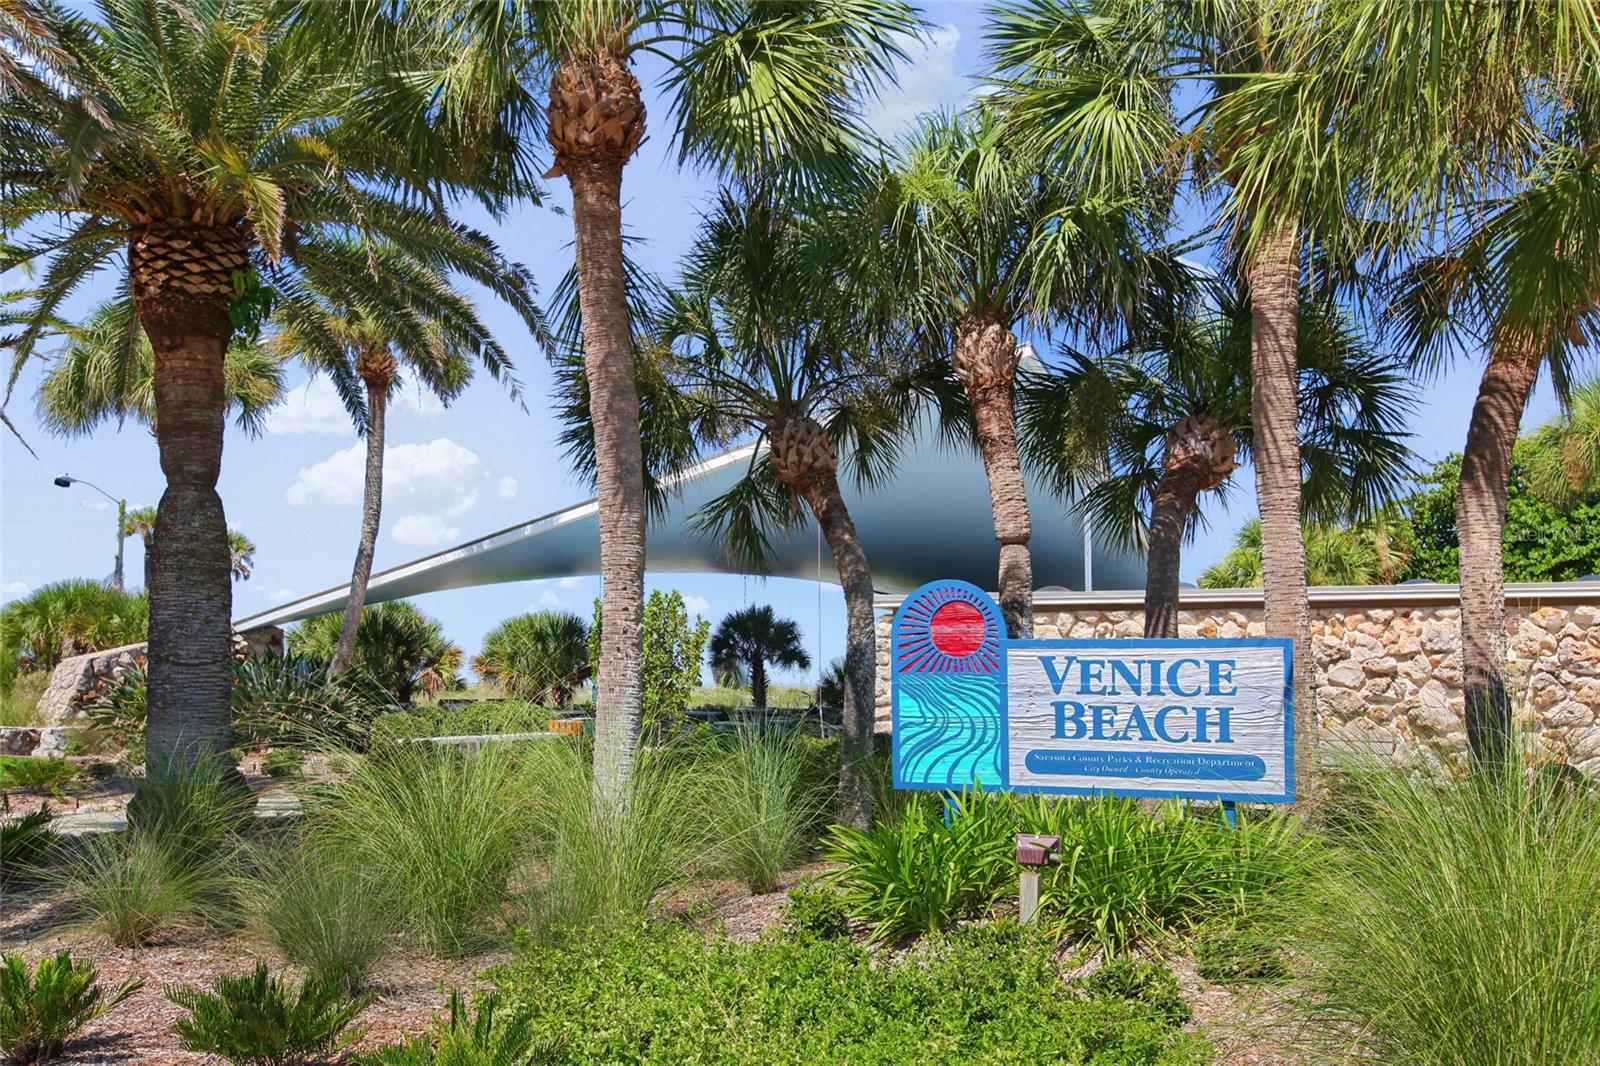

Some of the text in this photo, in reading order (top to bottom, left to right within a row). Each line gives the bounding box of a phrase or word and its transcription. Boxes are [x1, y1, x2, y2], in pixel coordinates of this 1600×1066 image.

[1037, 655, 1238, 697] VENICE
[1050, 700, 1235, 743] BEACH
[1034, 752, 1255, 767] Sarasota County Parks & Recreation Department
[1084, 764, 1100, 773] City
[1102, 764, 1129, 773] Owned
[1135, 766, 1162, 775] County
[1164, 766, 1201, 775] Operated
